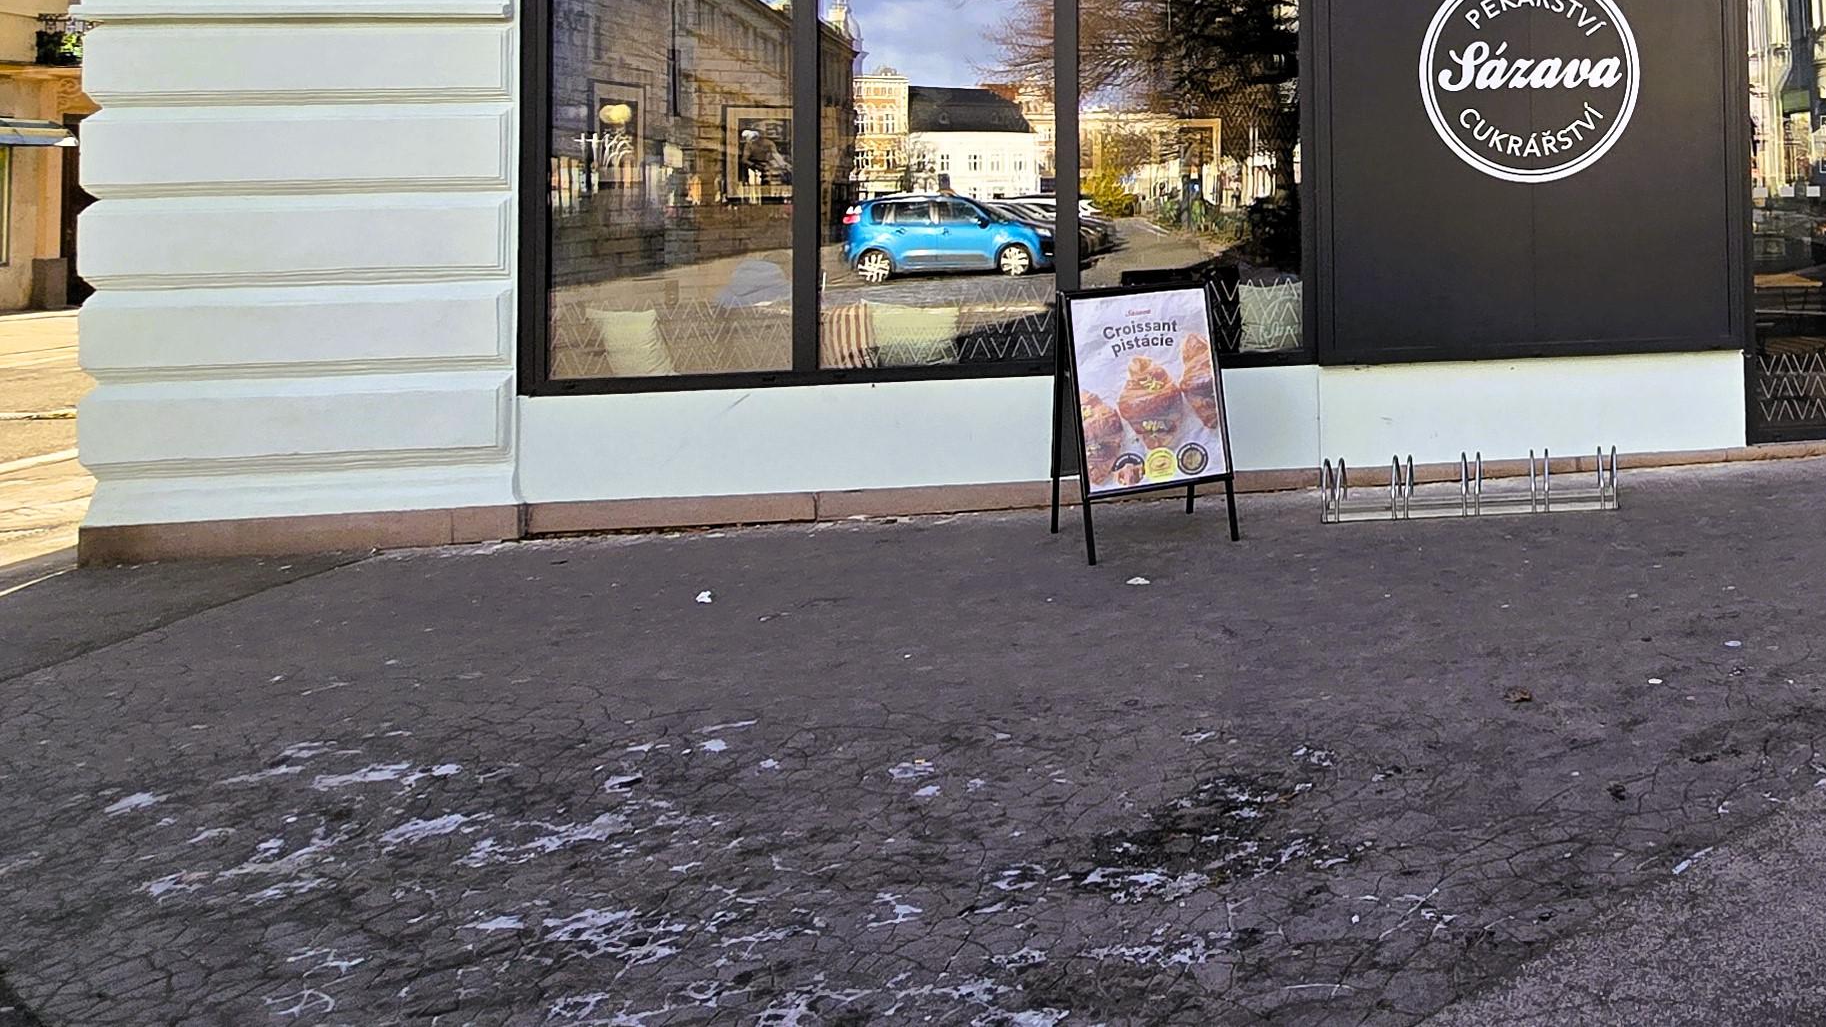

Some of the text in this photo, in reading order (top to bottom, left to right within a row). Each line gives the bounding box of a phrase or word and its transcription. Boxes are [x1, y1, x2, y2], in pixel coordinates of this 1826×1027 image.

[1437, 41, 1623, 91] Sázava
[1459, 101, 1604, 158] CUKRÁŘSTVÍ
[1102, 319, 1178, 341] Croissant
[1111, 333, 1174, 357] pistácie
